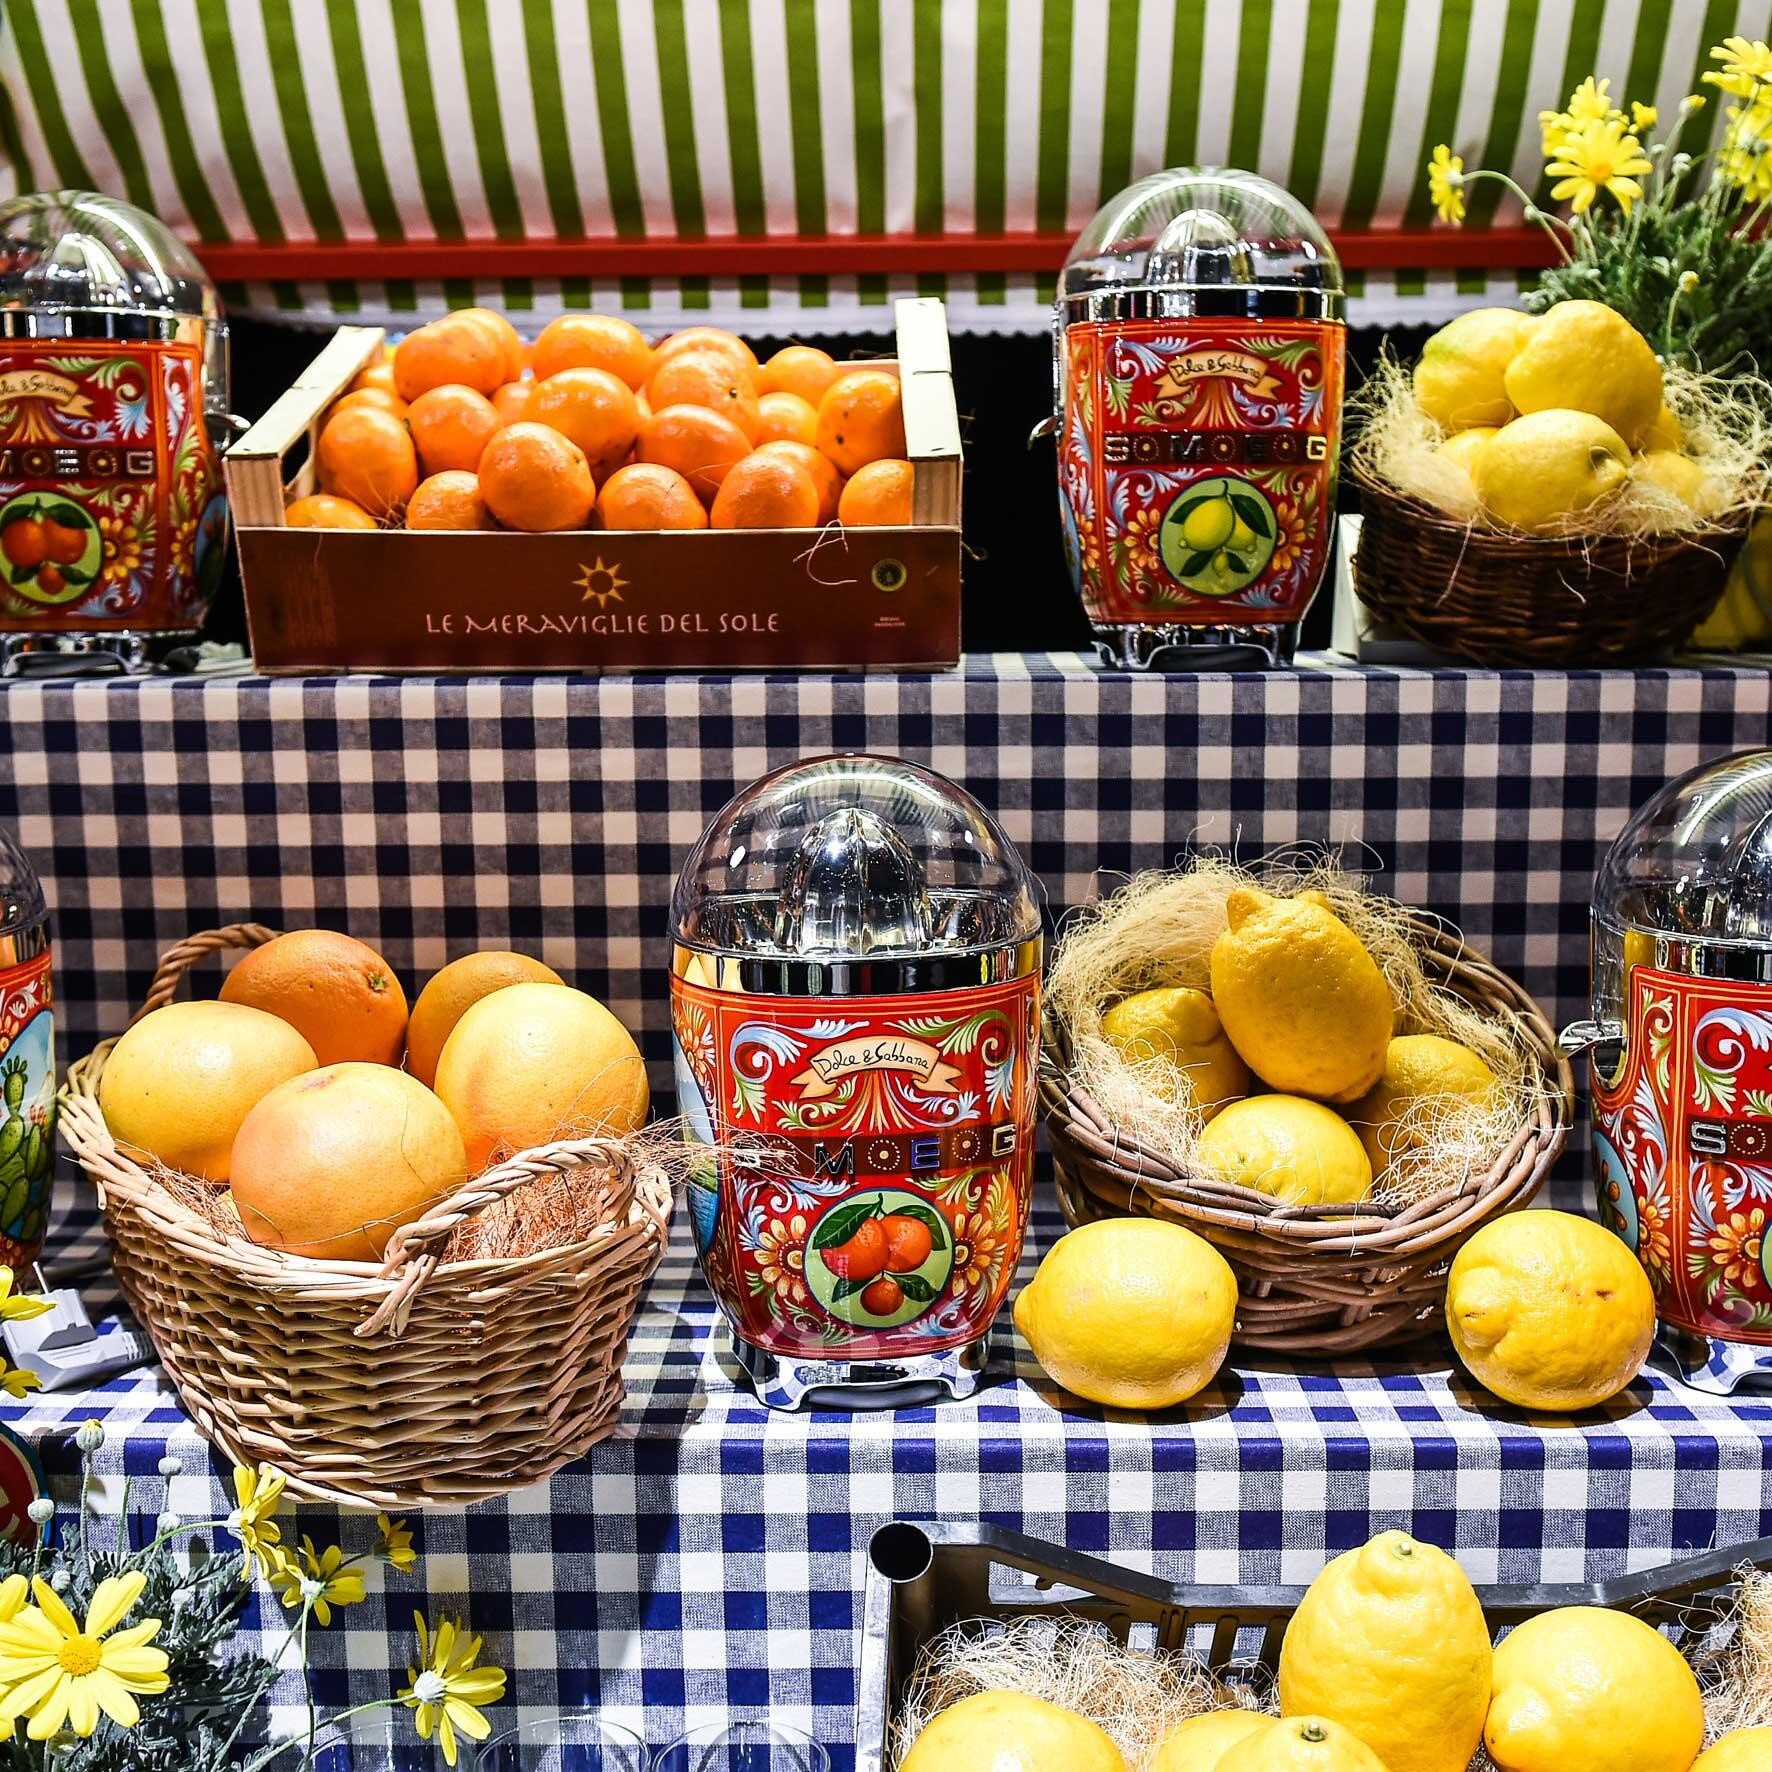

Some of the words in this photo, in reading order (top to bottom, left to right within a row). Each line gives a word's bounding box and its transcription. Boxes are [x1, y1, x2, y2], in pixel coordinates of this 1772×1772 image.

[1207, 359, 1215, 370] &
[426, 613, 453, 634] LE
[464, 613, 649, 636] MERAVIGLIE
[659, 613, 710, 634] DEL
[719, 612, 780, 634] SOLE
[813, 1050, 860, 1076] Dolce
[863, 1049, 874, 1063] &
[864, 1042, 929, 1069] Gabbana
